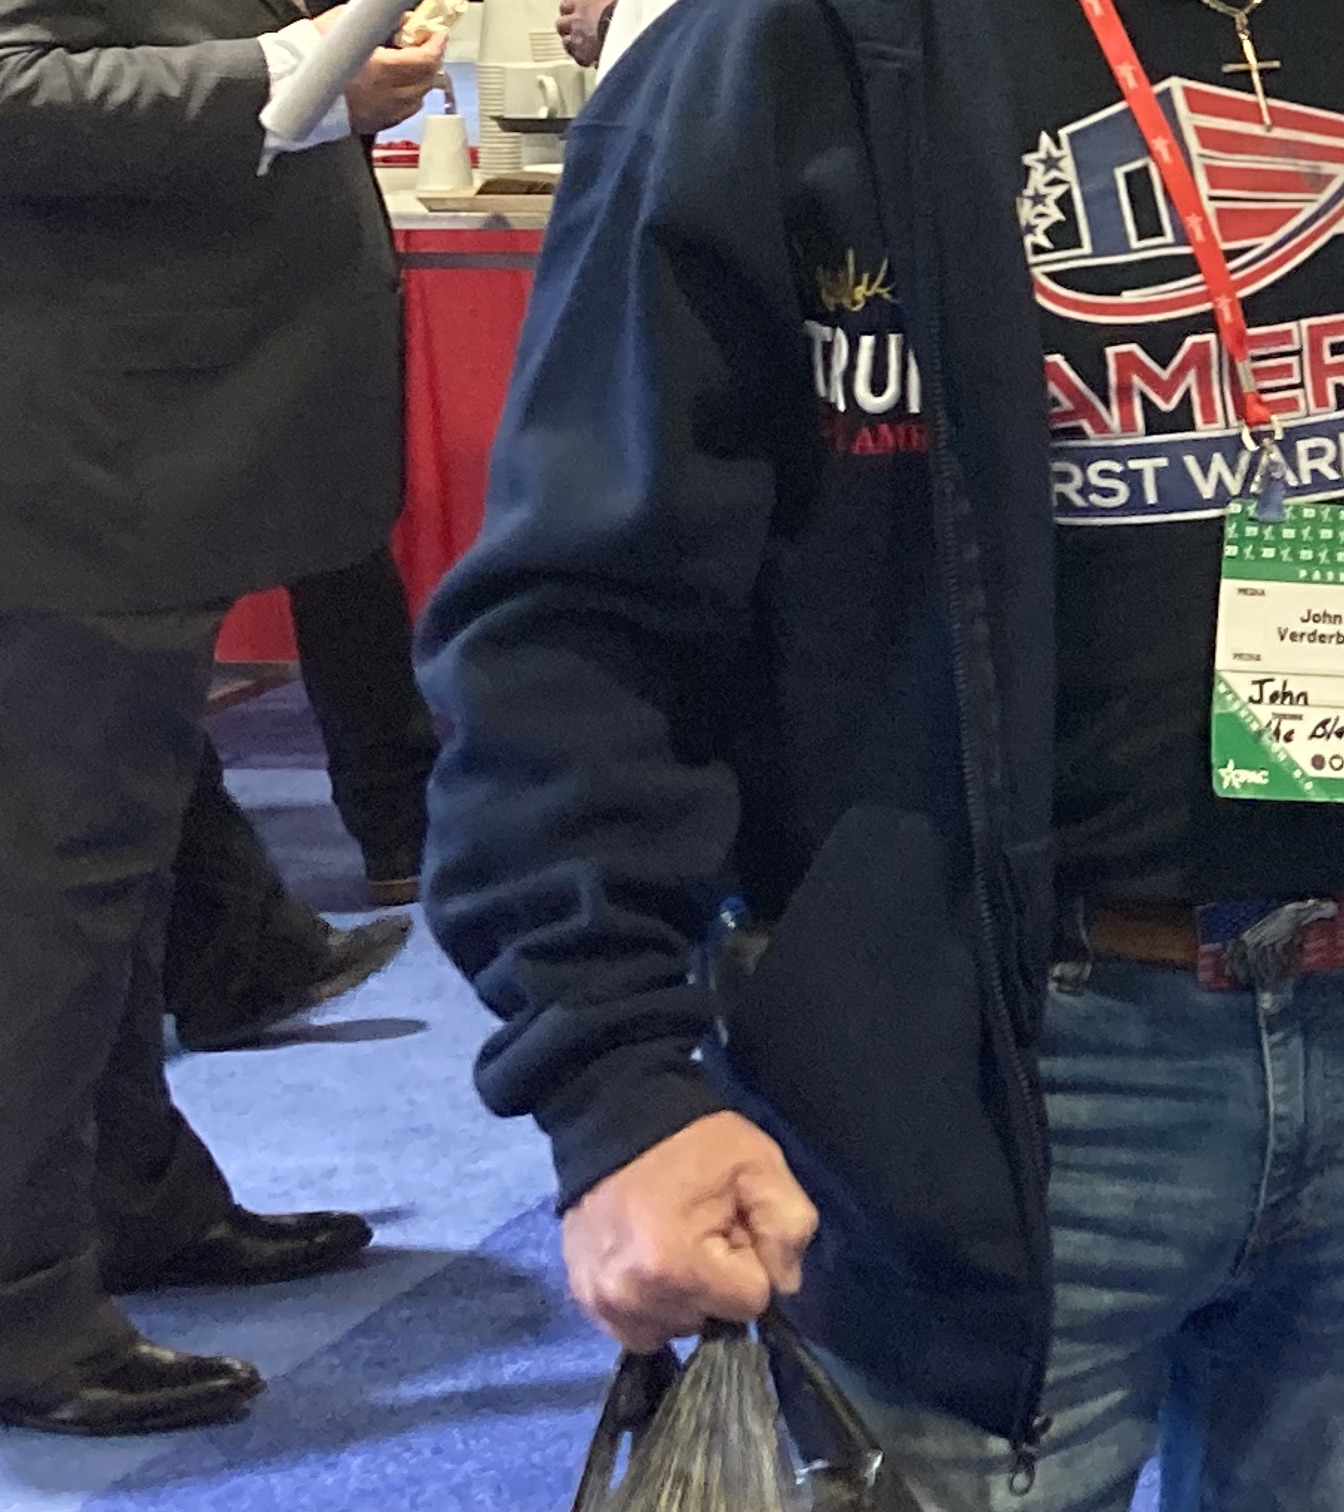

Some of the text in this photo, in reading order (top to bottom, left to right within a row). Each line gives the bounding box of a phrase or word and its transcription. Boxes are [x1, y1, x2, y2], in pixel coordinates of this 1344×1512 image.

[1050, 457, 1169, 507] RST
[1300, 608, 1343, 625] John
[1248, 677, 1309, 706] John
